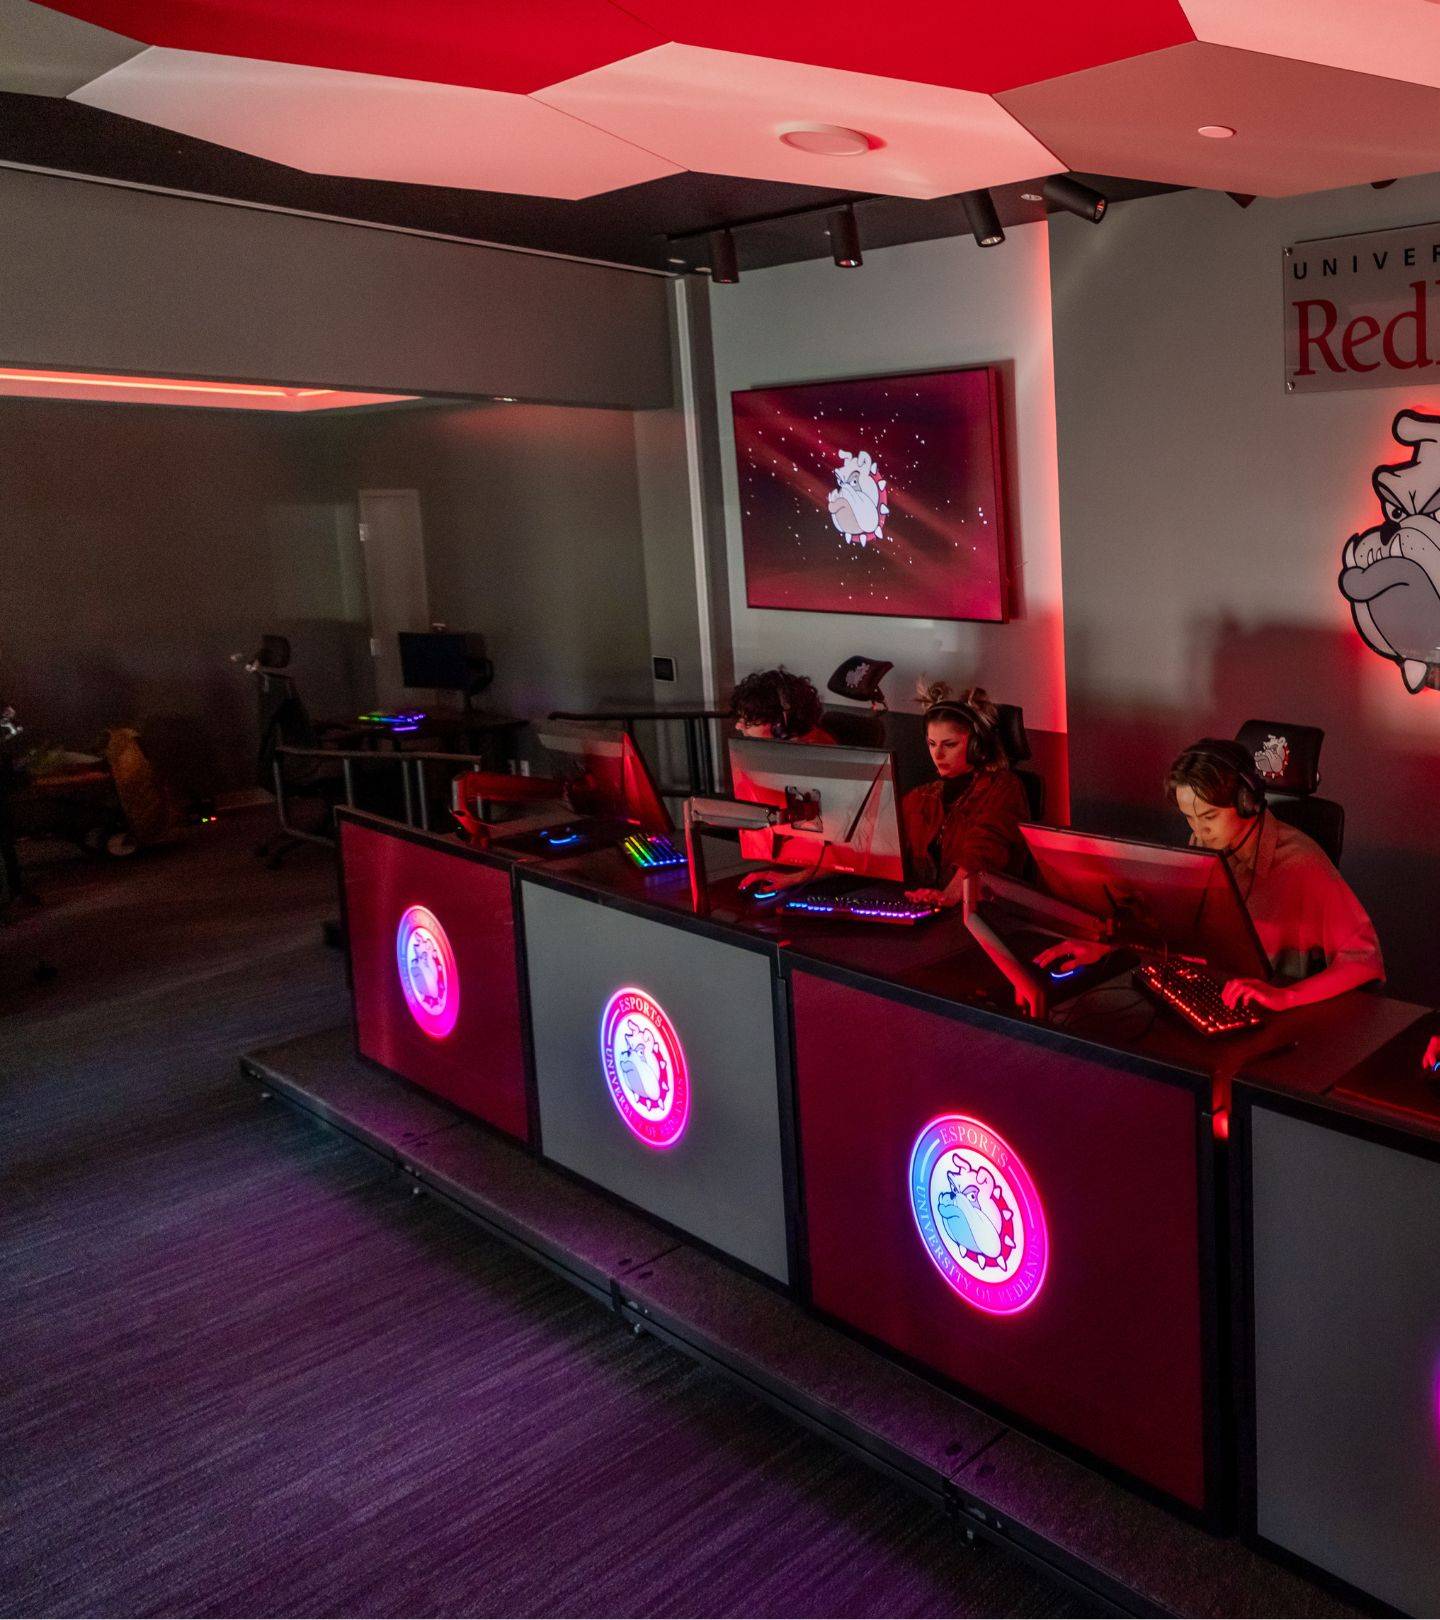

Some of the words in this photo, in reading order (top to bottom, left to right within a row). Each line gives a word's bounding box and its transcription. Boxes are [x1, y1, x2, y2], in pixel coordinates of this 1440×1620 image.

[618, 996, 662, 1027] ESPORTS
[939, 1125, 1008, 1168] ESPORTS
[916, 1186, 969, 1290] UNIVERSITY
